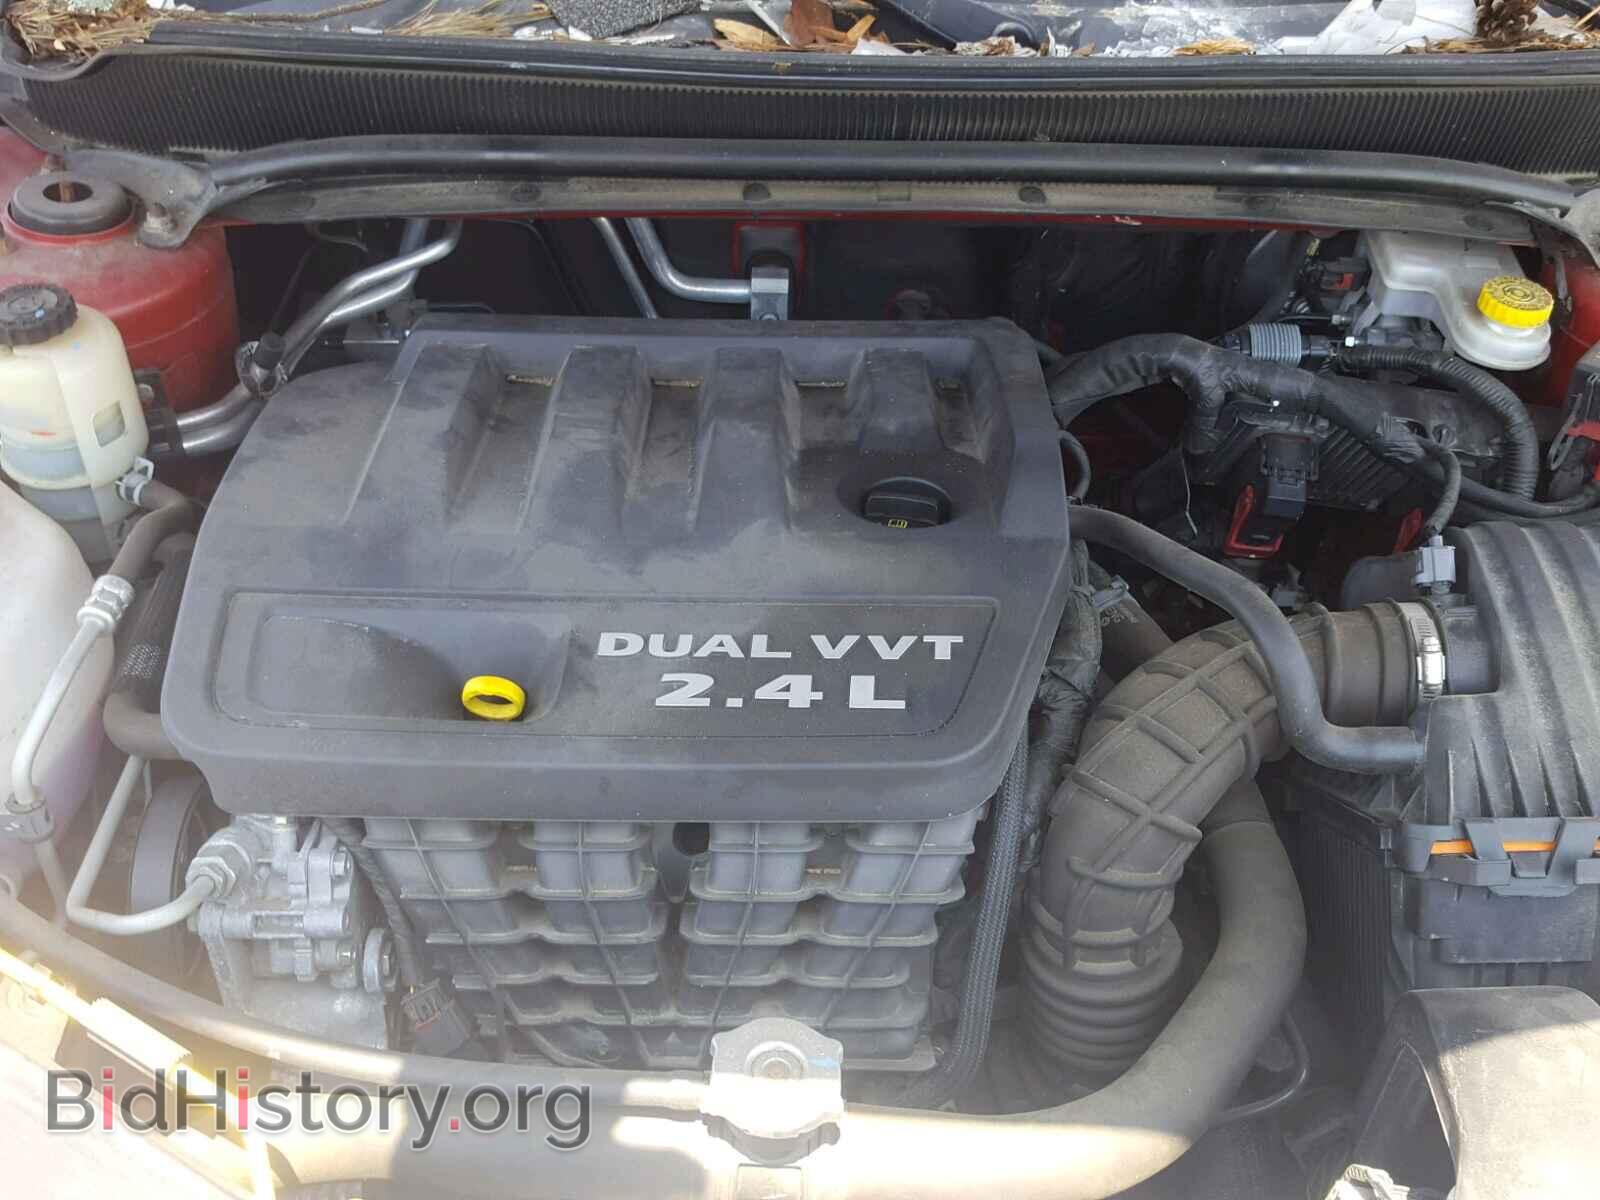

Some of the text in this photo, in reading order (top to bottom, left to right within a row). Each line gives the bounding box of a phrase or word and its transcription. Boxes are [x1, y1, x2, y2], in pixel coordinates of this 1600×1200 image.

[596, 631, 964, 661] DUAL VVT
[654, 672, 906, 710] 2.4 L
